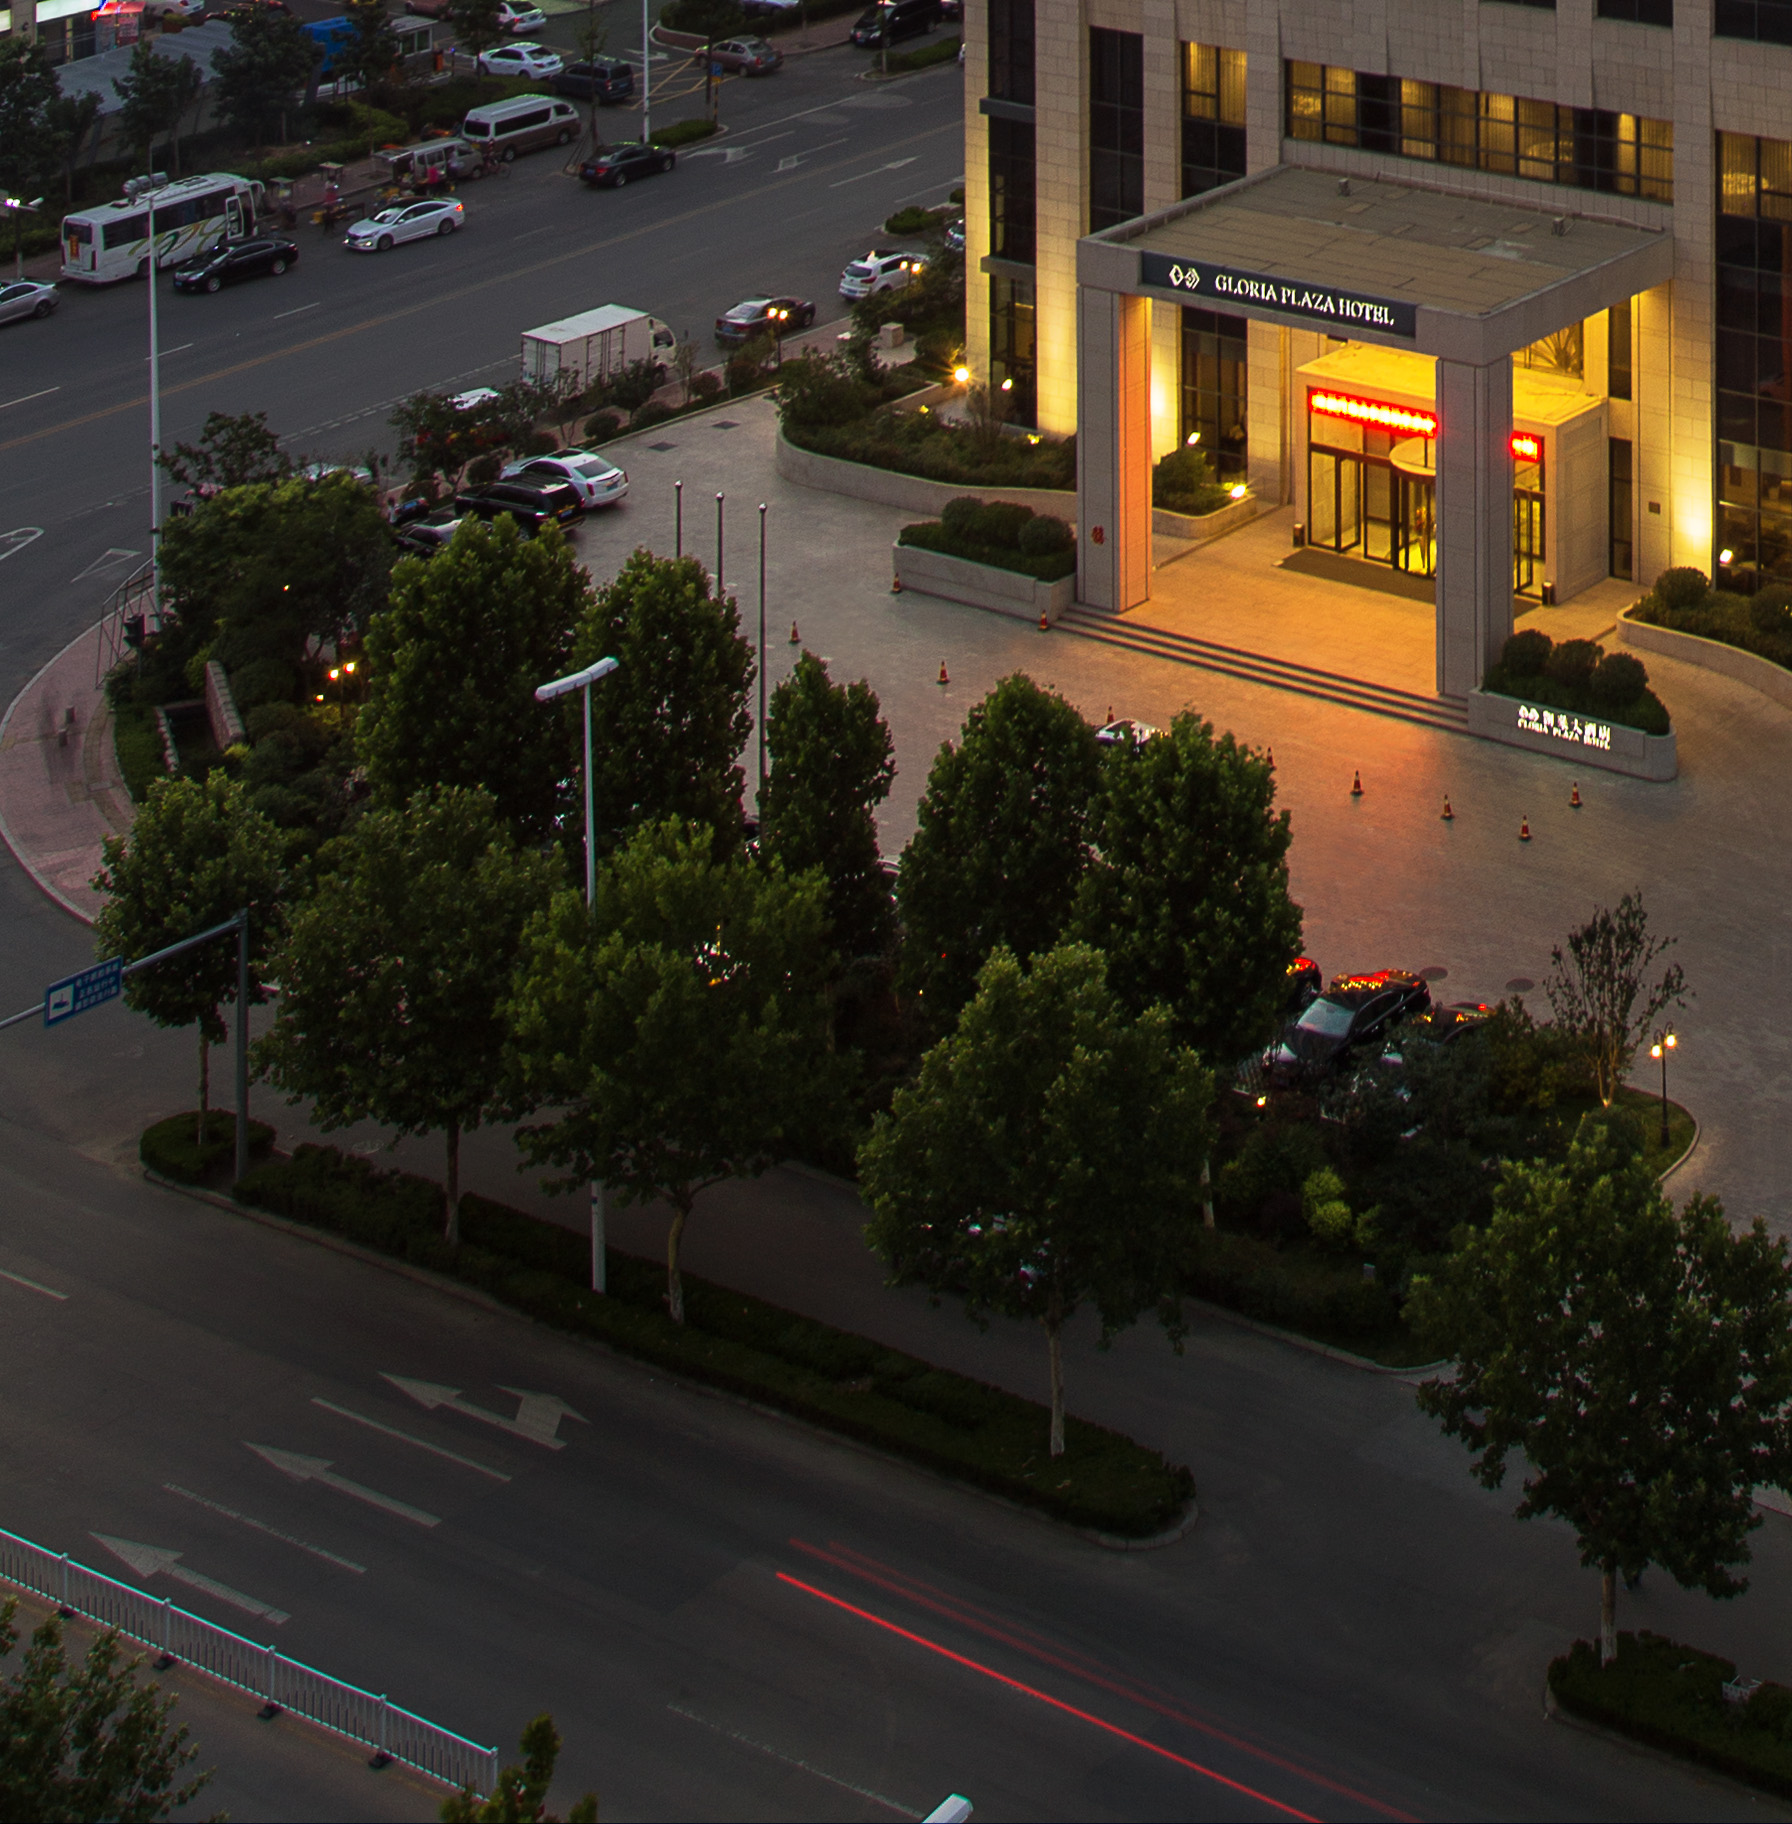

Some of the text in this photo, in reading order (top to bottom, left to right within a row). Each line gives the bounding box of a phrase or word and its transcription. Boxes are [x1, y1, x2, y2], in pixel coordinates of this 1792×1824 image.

[1215, 274, 1395, 326] GLORIA PLAZA HOTEL
